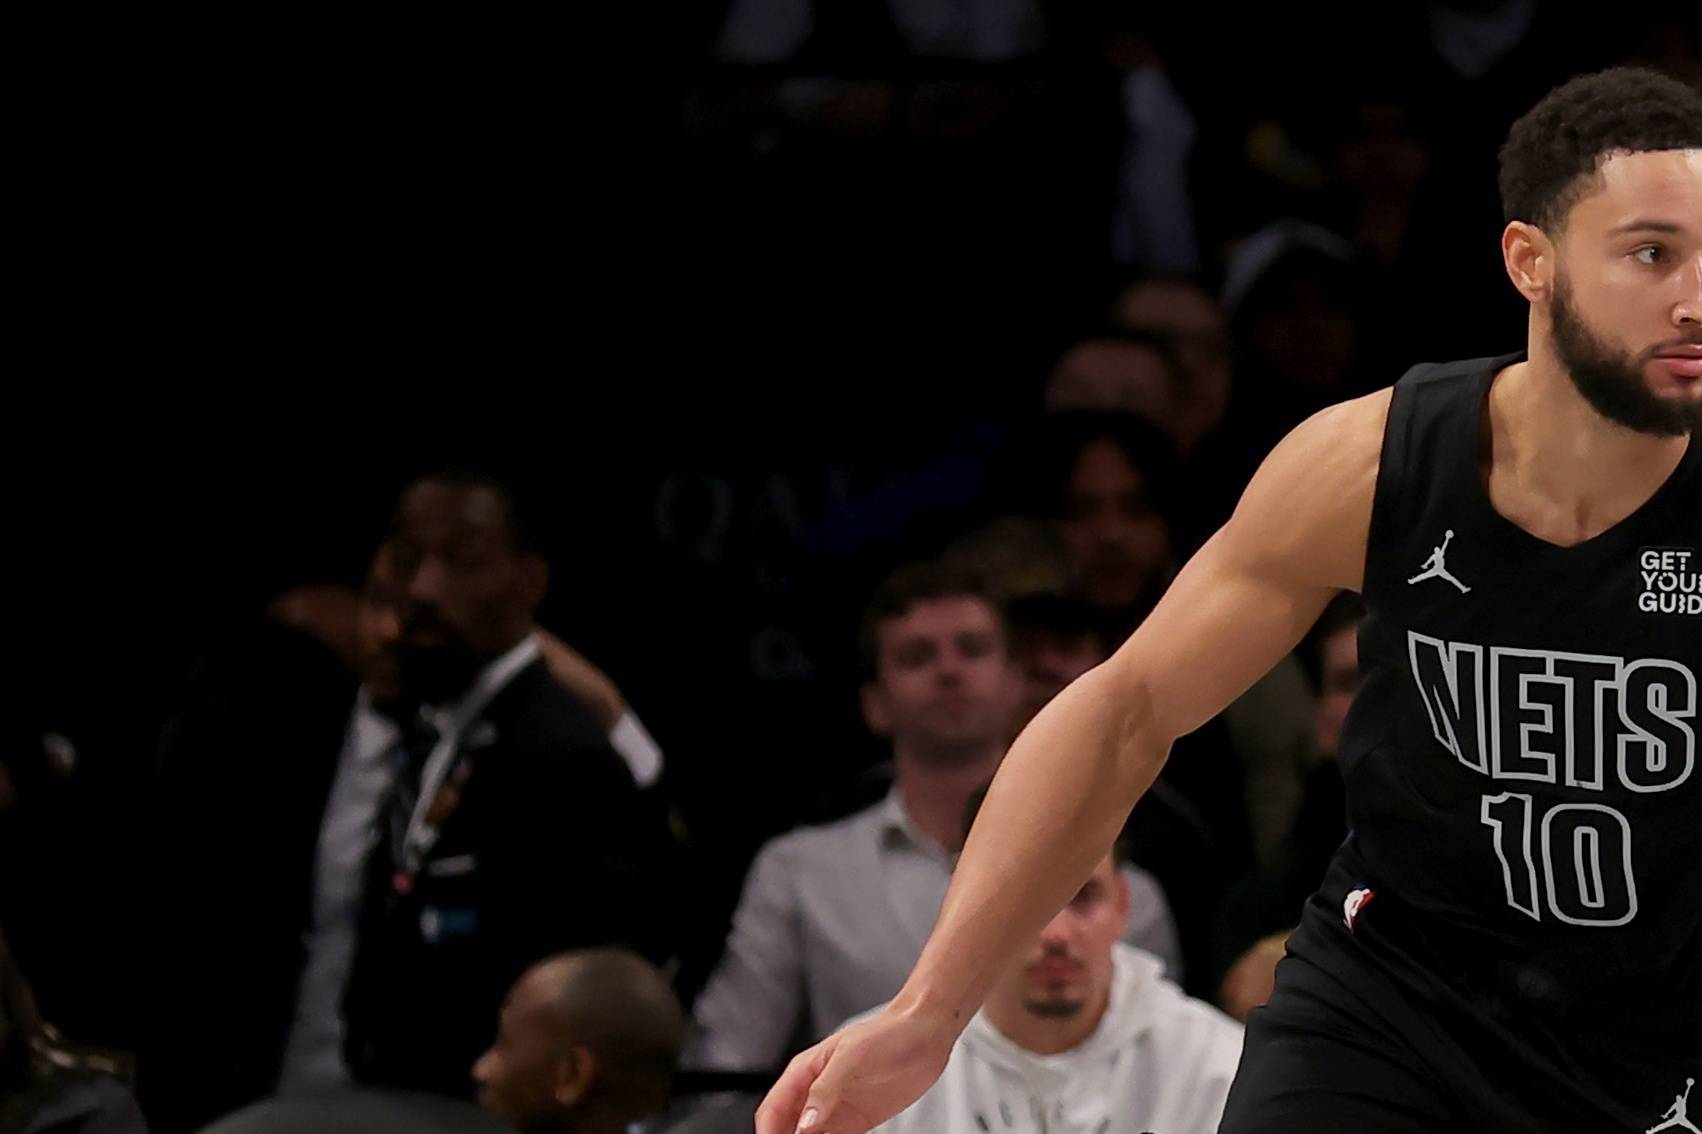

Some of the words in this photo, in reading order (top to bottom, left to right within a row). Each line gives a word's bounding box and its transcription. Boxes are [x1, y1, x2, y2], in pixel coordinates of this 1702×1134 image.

[1640, 550, 1692, 571] GET
[1407, 630, 1697, 793] NETS
[1480, 791, 1638, 927] 10
